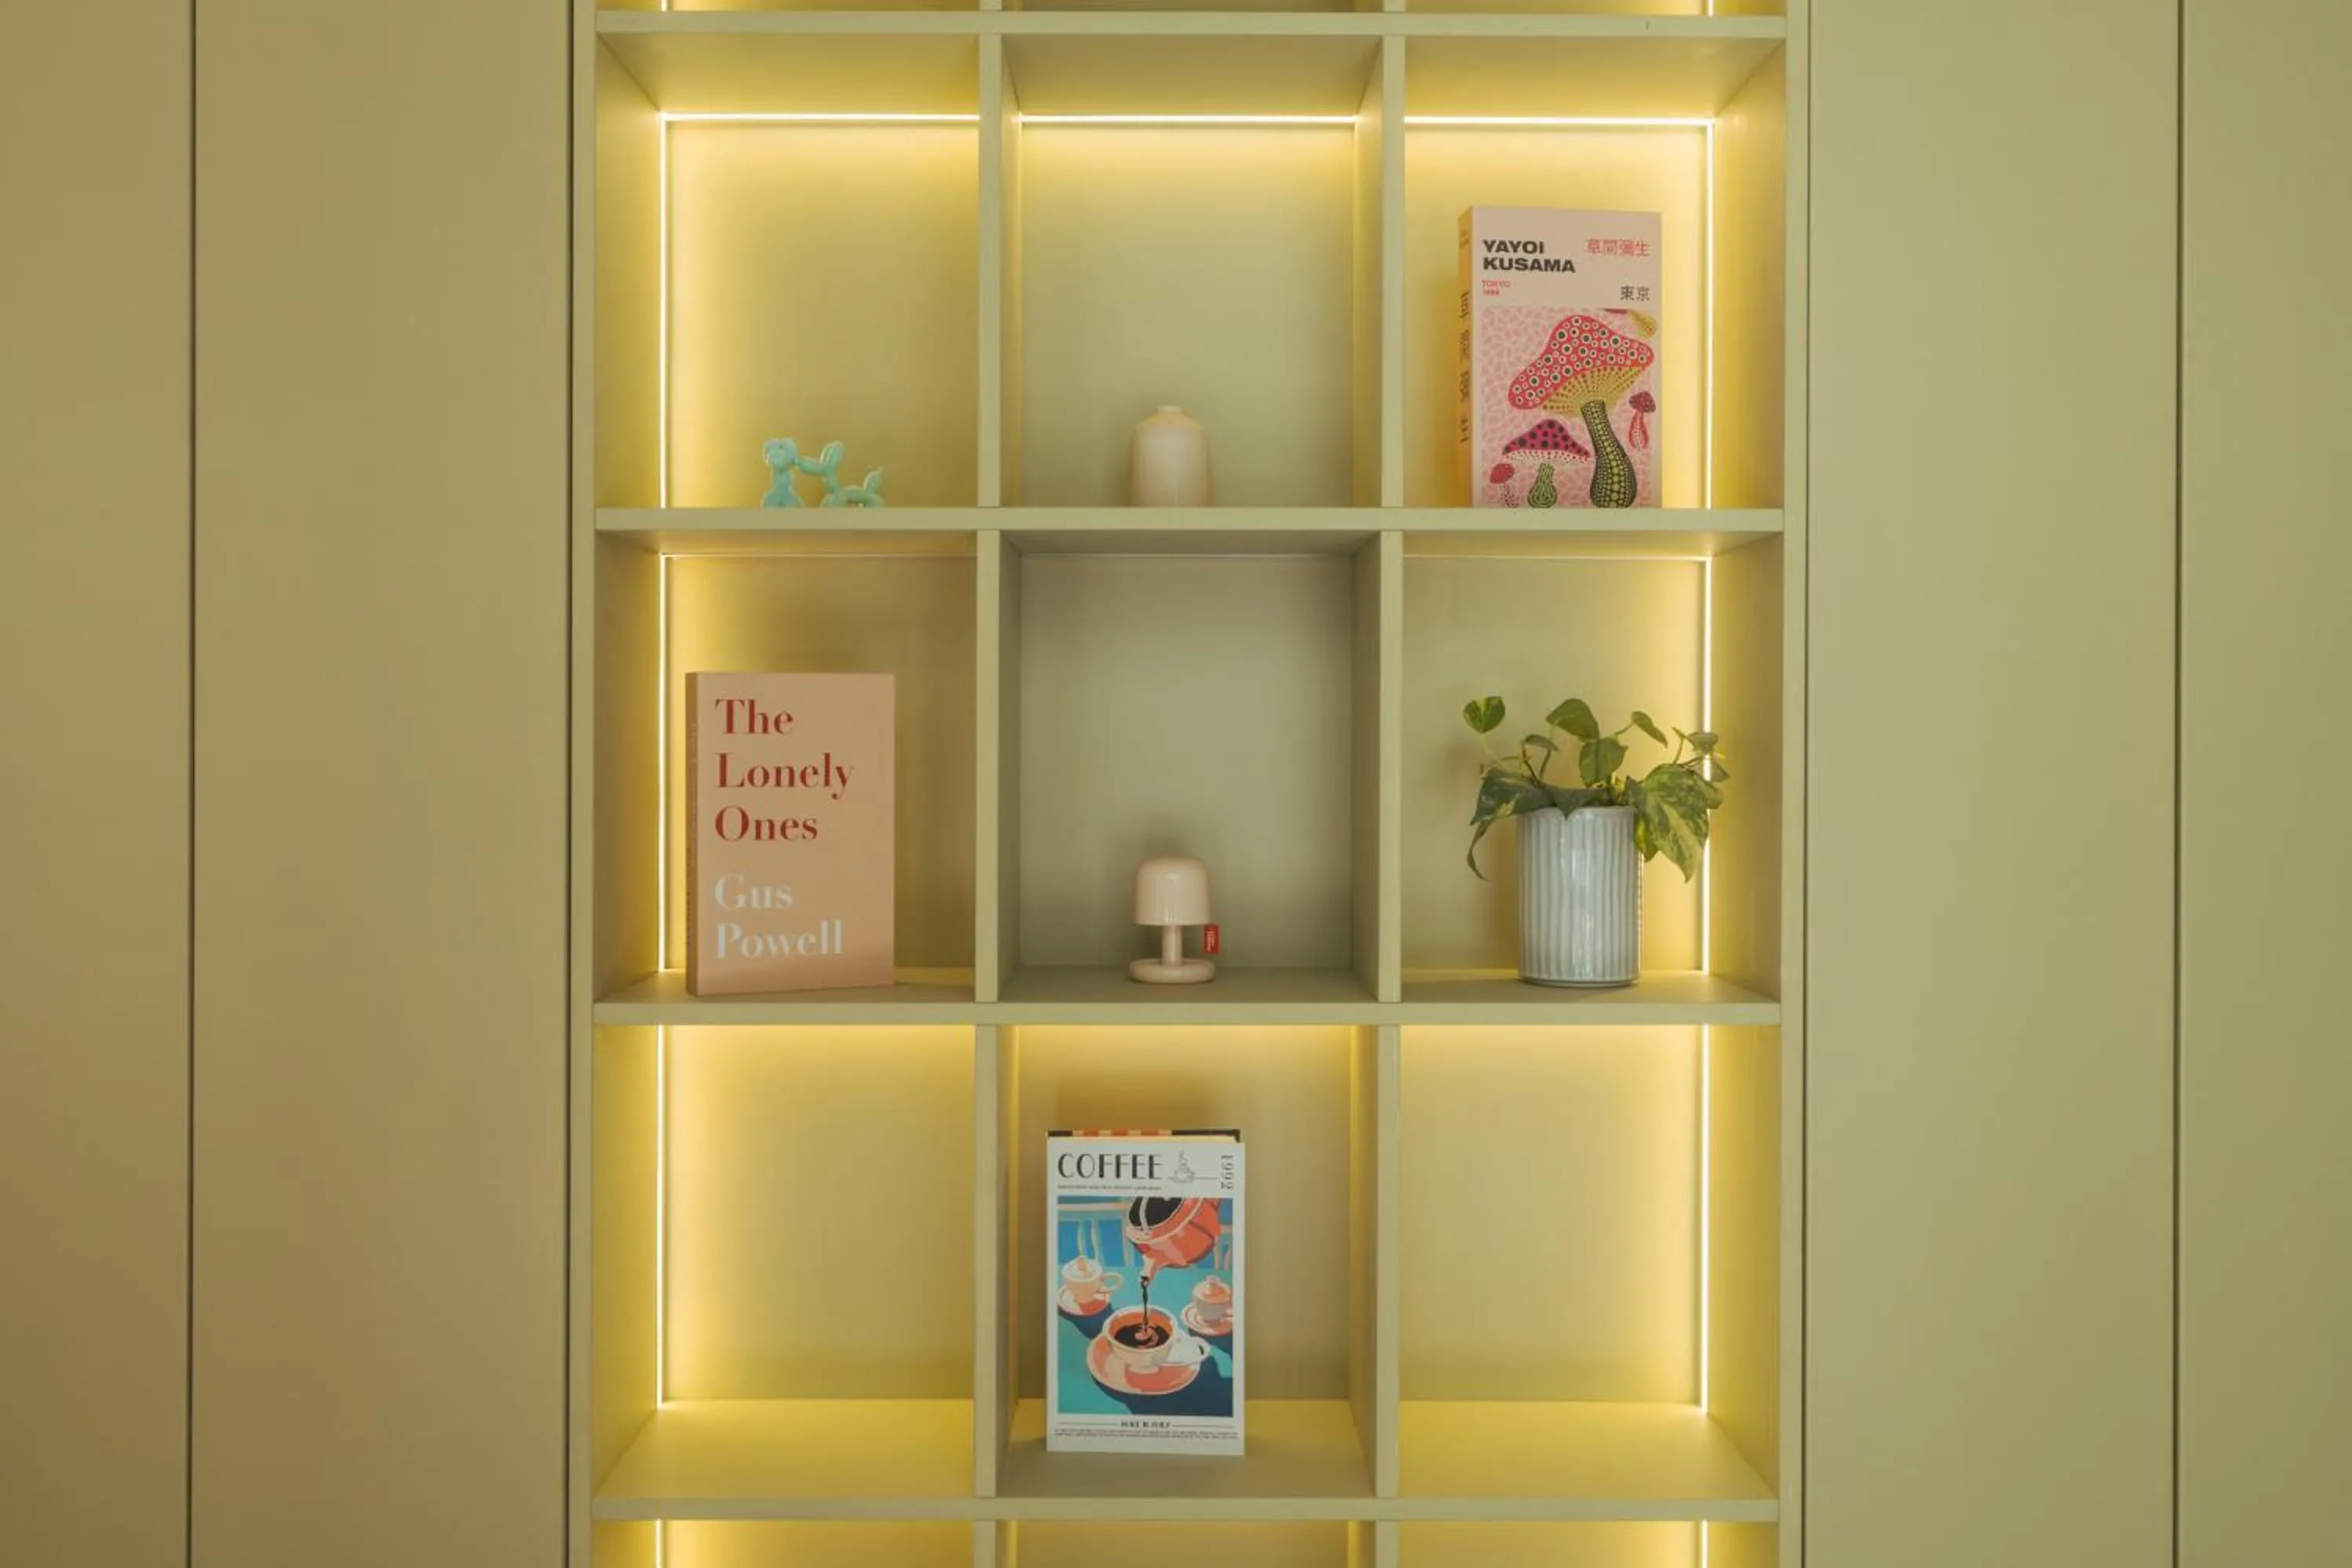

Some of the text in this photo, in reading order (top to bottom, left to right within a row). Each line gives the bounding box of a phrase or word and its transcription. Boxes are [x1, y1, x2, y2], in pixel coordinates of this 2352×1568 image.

[1483, 239, 1544, 254] YAYOI
[1483, 257, 1576, 273] KUSAMA
[1620, 285, 1650, 301] 東京
[715, 699, 794, 735] The
[715, 751, 854, 800] Lonely
[714, 806, 818, 842] Ones
[714, 873, 793, 909] Gus
[714, 919, 844, 958] Powell
[1058, 1153, 1162, 1179] COFFEE
[1221, 1155, 1233, 1189] 1992
